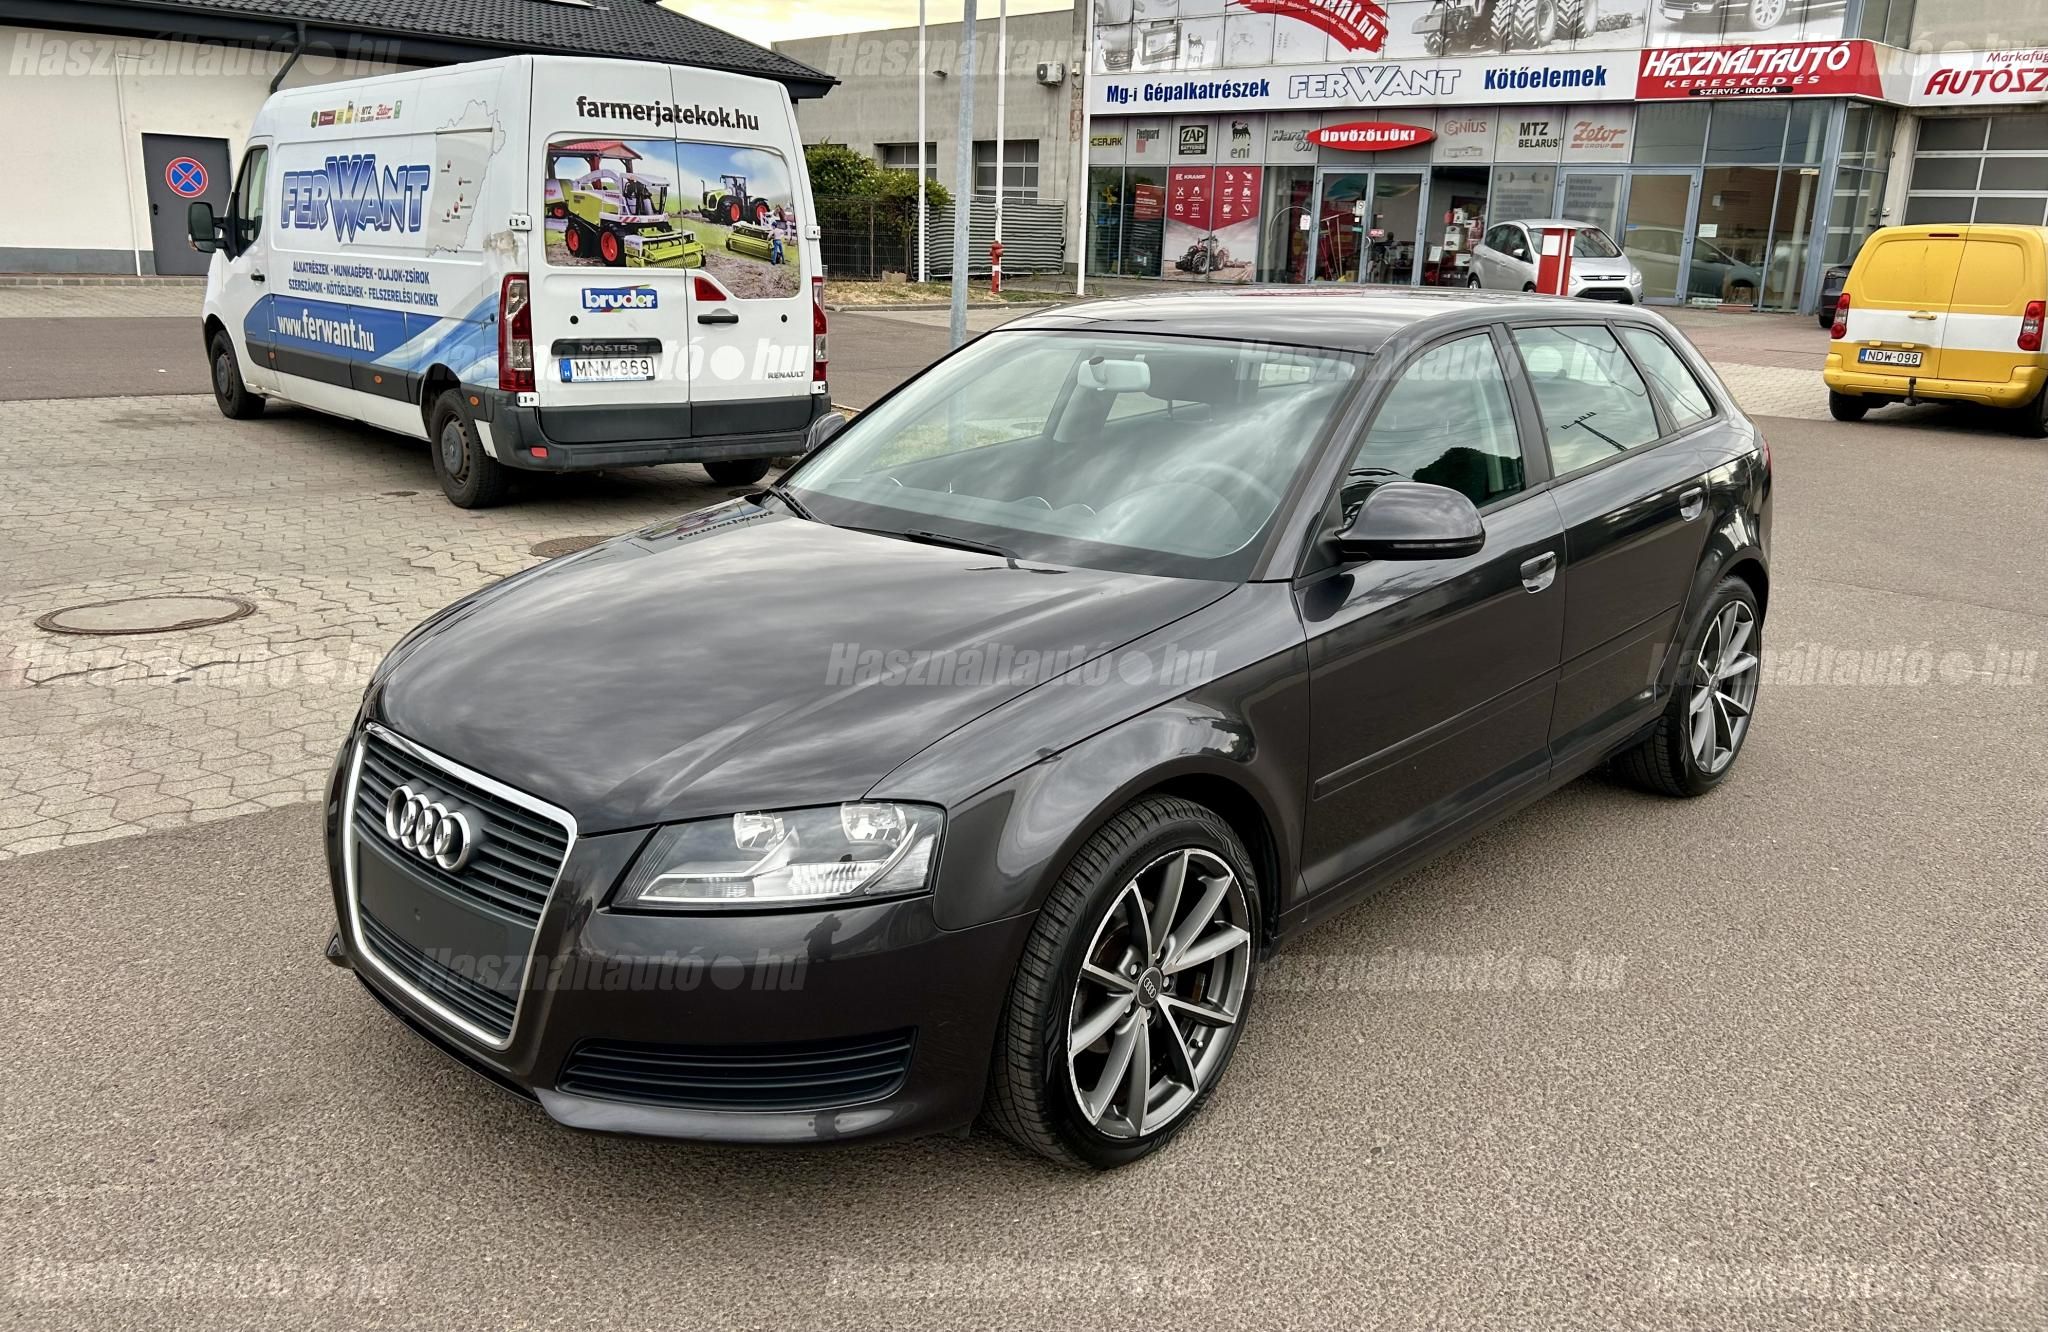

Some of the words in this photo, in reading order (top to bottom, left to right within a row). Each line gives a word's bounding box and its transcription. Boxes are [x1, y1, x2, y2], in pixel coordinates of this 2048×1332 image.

[1641, 42, 1850, 77] HASZNÁLTAUTÓ
[1288, 66, 1461, 102] FERWANT
[1484, 65, 1607, 90] Kötőelemek
[1664, 74, 1820, 88] KERESKEDÉS
[1924, 63, 2048, 96] AUTÓSZ
[1106, 85, 1137, 104] Mg-i
[1144, 78, 1270, 103] Gépalkatrészek
[1700, 86, 1777, 96] SZERVIZ-IRODA
[576, 96, 759, 131] farmerjatekok.hu
[1182, 129, 1204, 142] ZAP
[1320, 129, 1416, 142] ÜDVÖZÖLJÜK!
[1519, 122, 1548, 136] MTZ
[1573, 121, 1628, 142] Zetor
[1230, 144, 1250, 159] eni
[1518, 138, 1558, 148] BELARUS
[281, 154, 430, 242] FERWANT
[293, 260, 329, 275] ALKATRÉSZEK
[334, 264, 373, 280] MUNKAGÉPEK
[288, 278, 323, 293] SZERSZÁMOK
[368, 287, 413, 304] FELSZERELÉSI
[413, 291, 439, 306] CIKKEK
[584, 290, 655, 308] bruder
[277, 308, 375, 352] www.ferwant.hu
[1867, 351, 1919, 364] NDW-098
[574, 360, 650, 377] MNM-869
[767, 370, 806, 379] RENAULT
